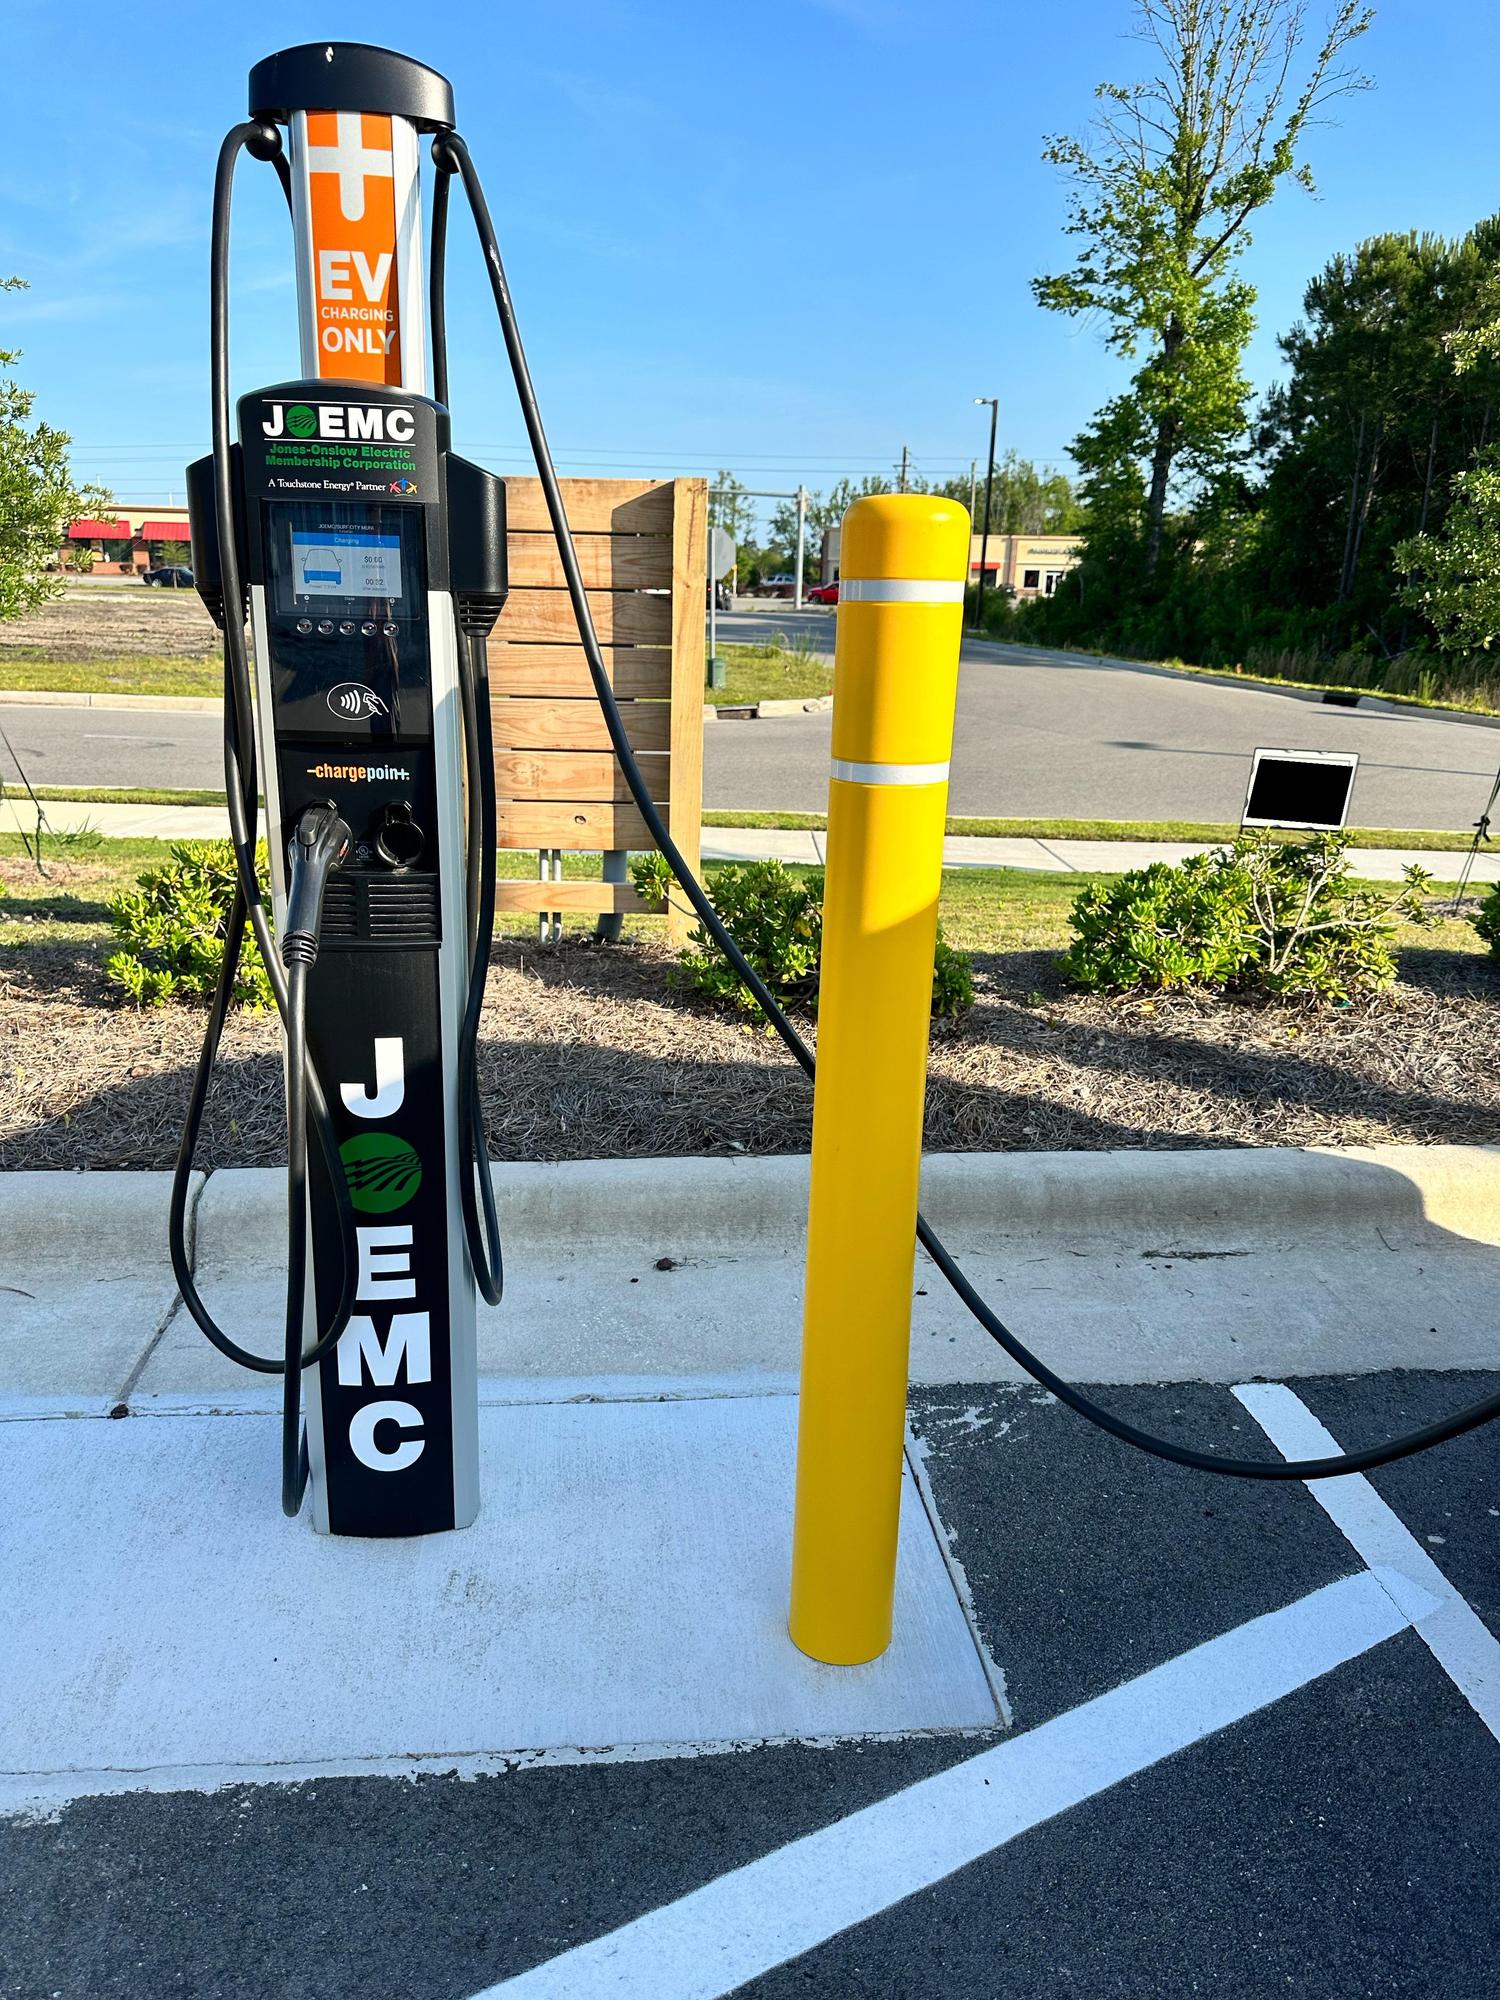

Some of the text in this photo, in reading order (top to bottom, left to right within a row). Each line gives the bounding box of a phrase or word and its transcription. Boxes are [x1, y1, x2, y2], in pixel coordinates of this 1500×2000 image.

[319, 249, 393, 302] EV
[321, 306, 394, 321] CHARGING
[322, 326, 396, 354] ONLY
[270, 443, 411, 459] Jones-Onslow Electric
[266, 455, 416, 471] Membership Corporation
[268, 478, 276, 488] A
[277, 478, 322, 489] Touchstone
[356, 480, 386, 491] Partner
